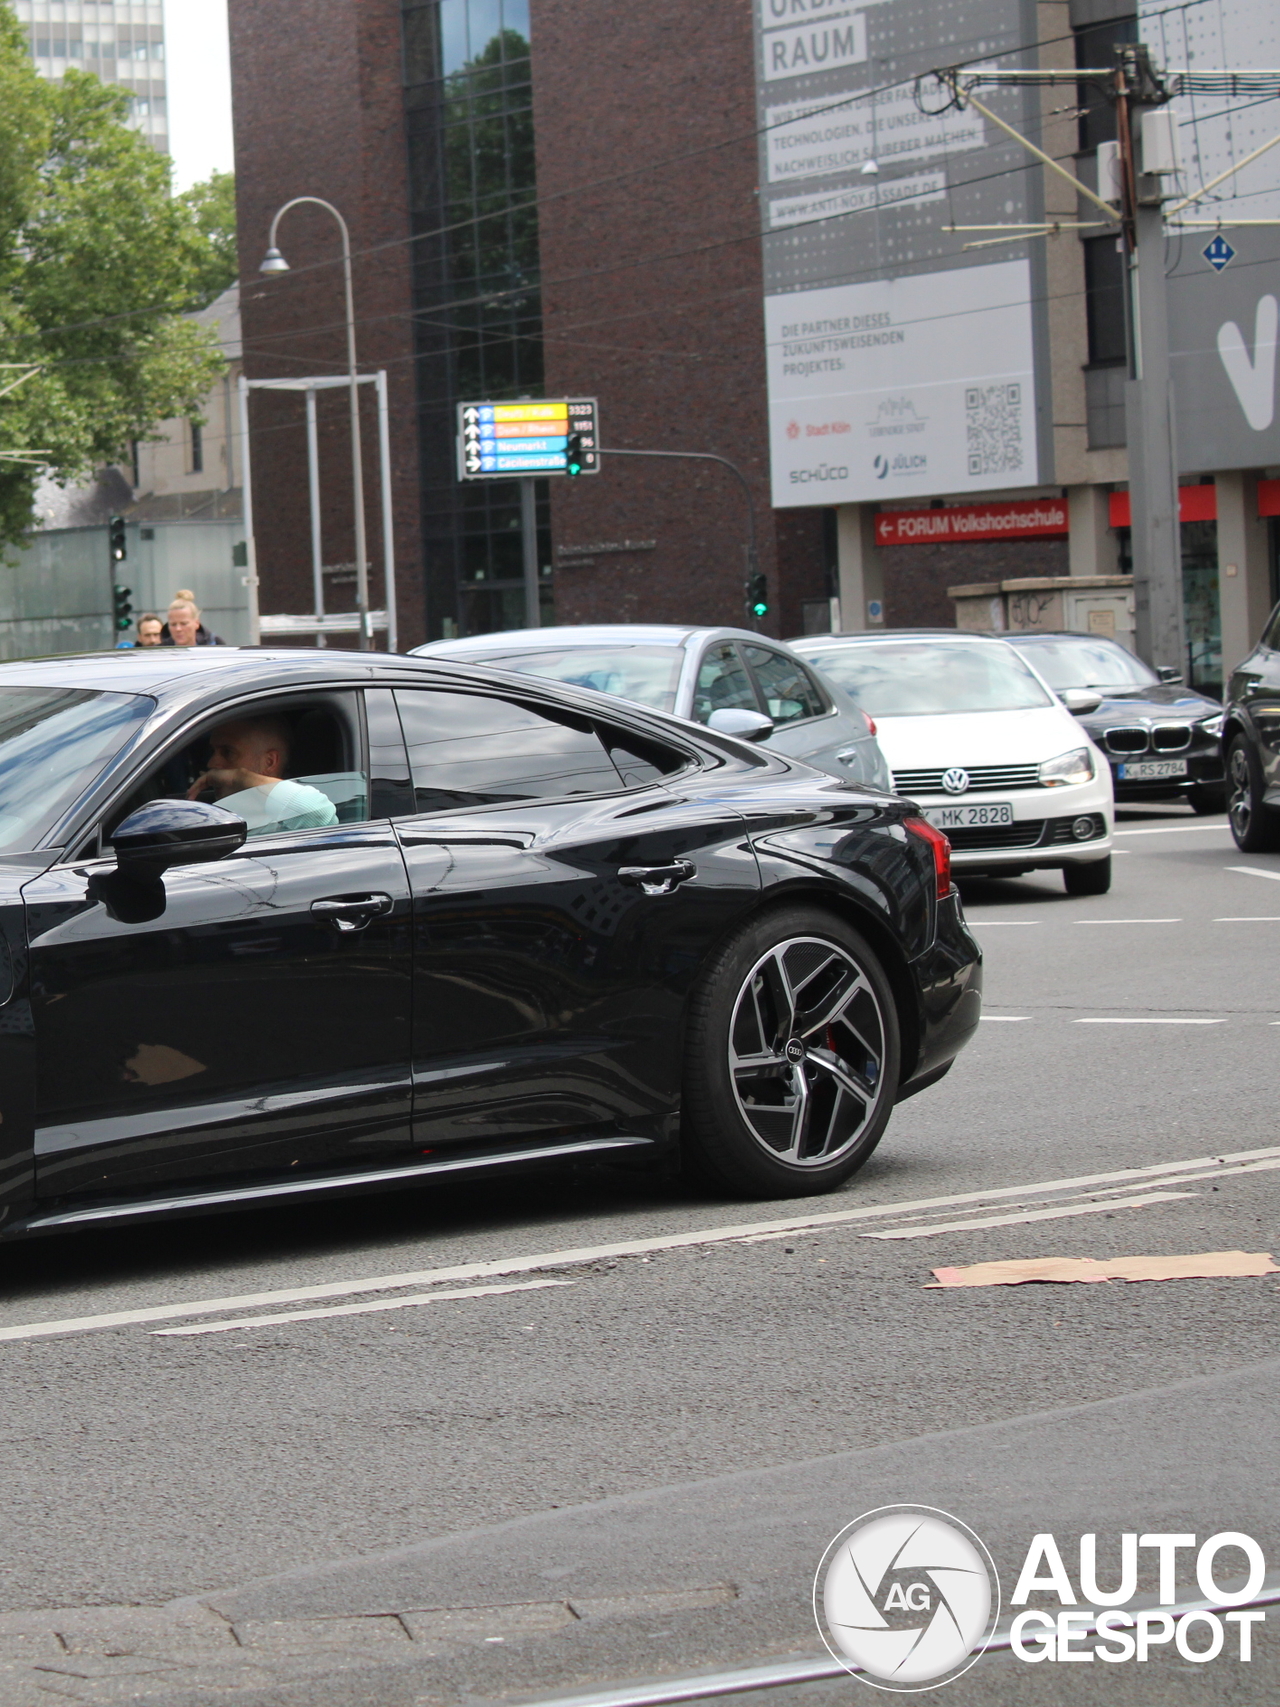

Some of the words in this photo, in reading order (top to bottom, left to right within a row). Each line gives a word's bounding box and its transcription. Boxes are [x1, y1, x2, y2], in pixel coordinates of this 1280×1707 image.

[772, 25, 855, 71] RAUM
[775, 150, 860, 174] NACHWEISLICH
[781, 323, 799, 338] DIE
[801, 317, 851, 335] PARTNER
[853, 312, 891, 331] DIESES
[782, 330, 905, 357] ZUKUNFTSWEISENDEN
[568, 404, 593, 416] 3323
[573, 420, 593, 431] 1151
[805, 423, 830, 437] Stadt
[831, 421, 852, 434] Köln
[497, 440, 548, 452] Neumarkt
[892, 453, 927, 471] JÜLICH
[789, 463, 849, 484] SCHÜCO
[898, 516, 949, 538] FORUM
[951, 505, 1065, 534] Volkshochschule
[1125, 765, 1133, 776] K
[1140, 764, 1154, 776] RS
[1157, 763, 1185, 775] 2784
[941, 809, 965, 826] MK
[968, 806, 1010, 825] 2828
